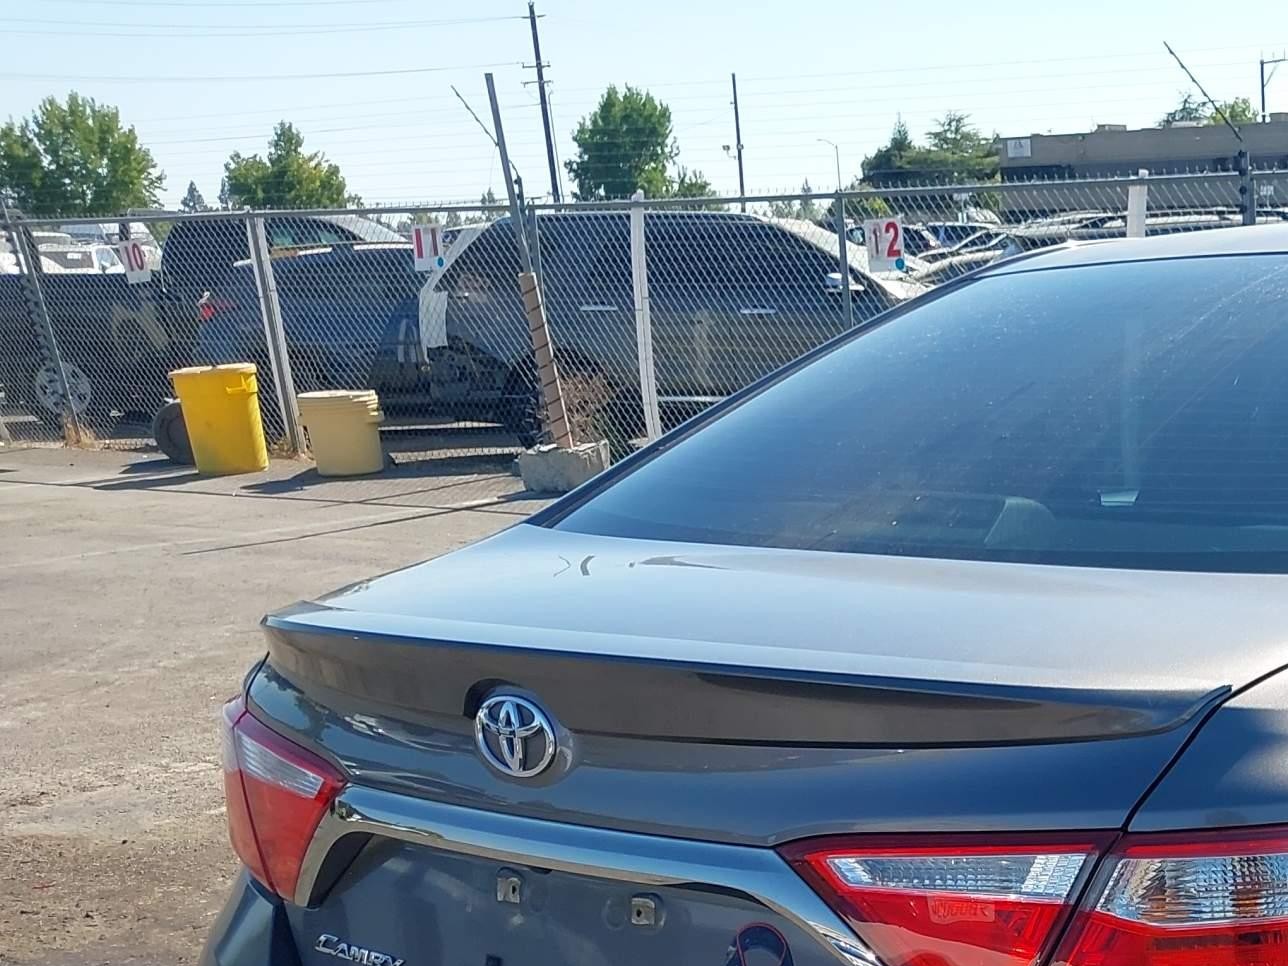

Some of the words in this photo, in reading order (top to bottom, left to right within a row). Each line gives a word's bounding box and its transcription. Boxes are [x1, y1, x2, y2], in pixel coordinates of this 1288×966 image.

[414, 228, 438, 258] 11
[870, 222, 901, 257] 12
[124, 242, 144, 271] 10
